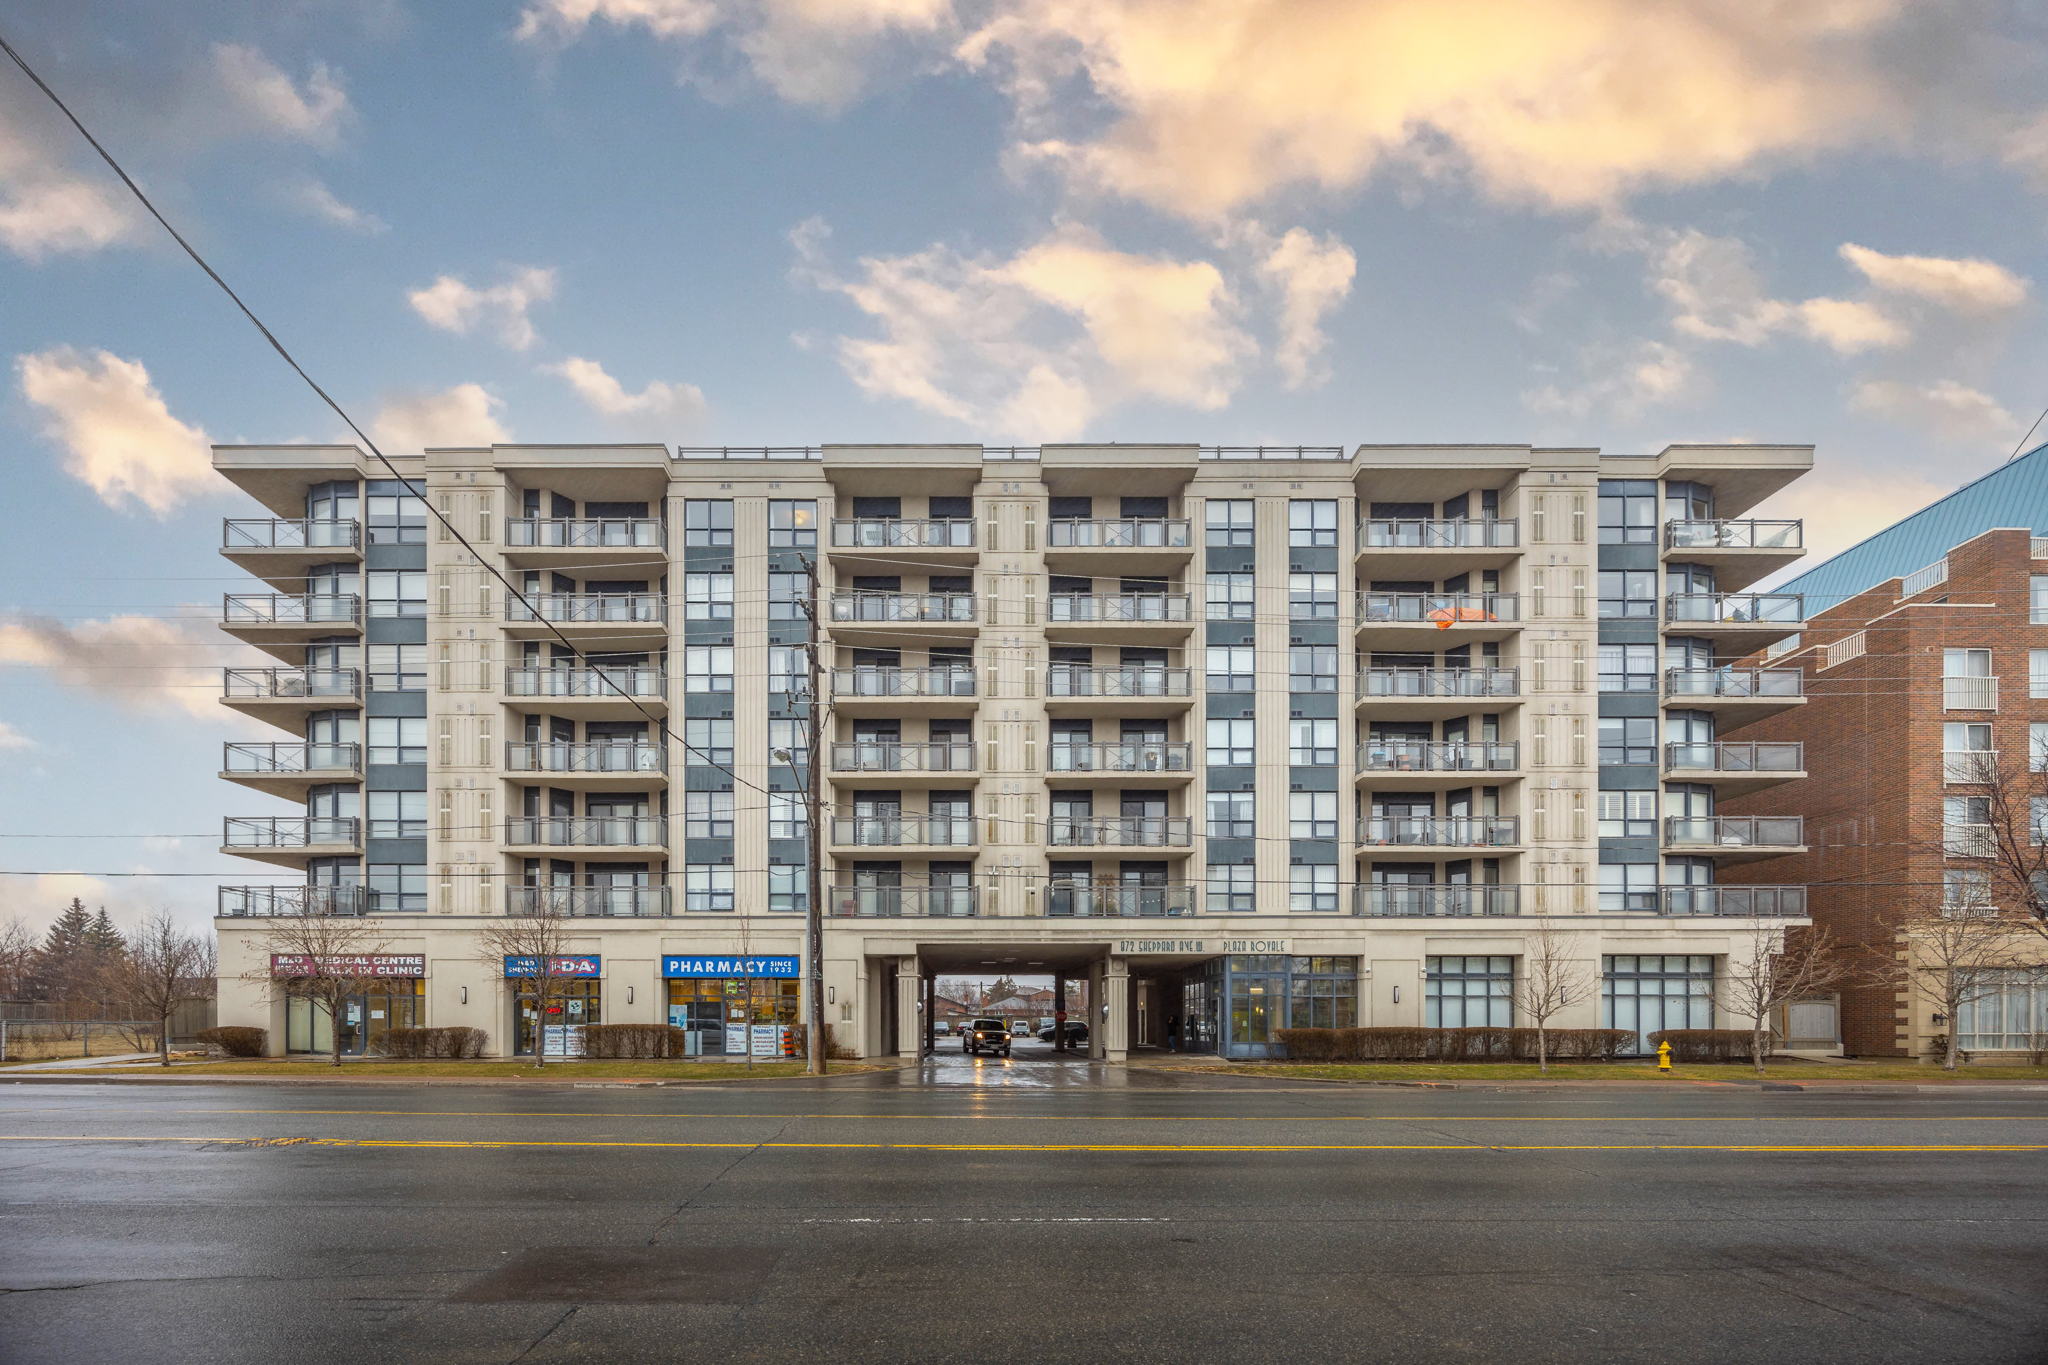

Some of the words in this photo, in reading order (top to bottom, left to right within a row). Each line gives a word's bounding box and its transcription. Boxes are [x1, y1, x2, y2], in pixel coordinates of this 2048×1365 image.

[1120, 941, 1134, 952] 872
[1138, 941, 1175, 952] SHEPPARD
[1223, 941, 1246, 952] PLAZA
[1250, 941, 1284, 952] ROYALE
[373, 956, 423, 965] CENTRE
[376, 966, 422, 975] CLINIC
[670, 961, 766, 973] PHARMACY
